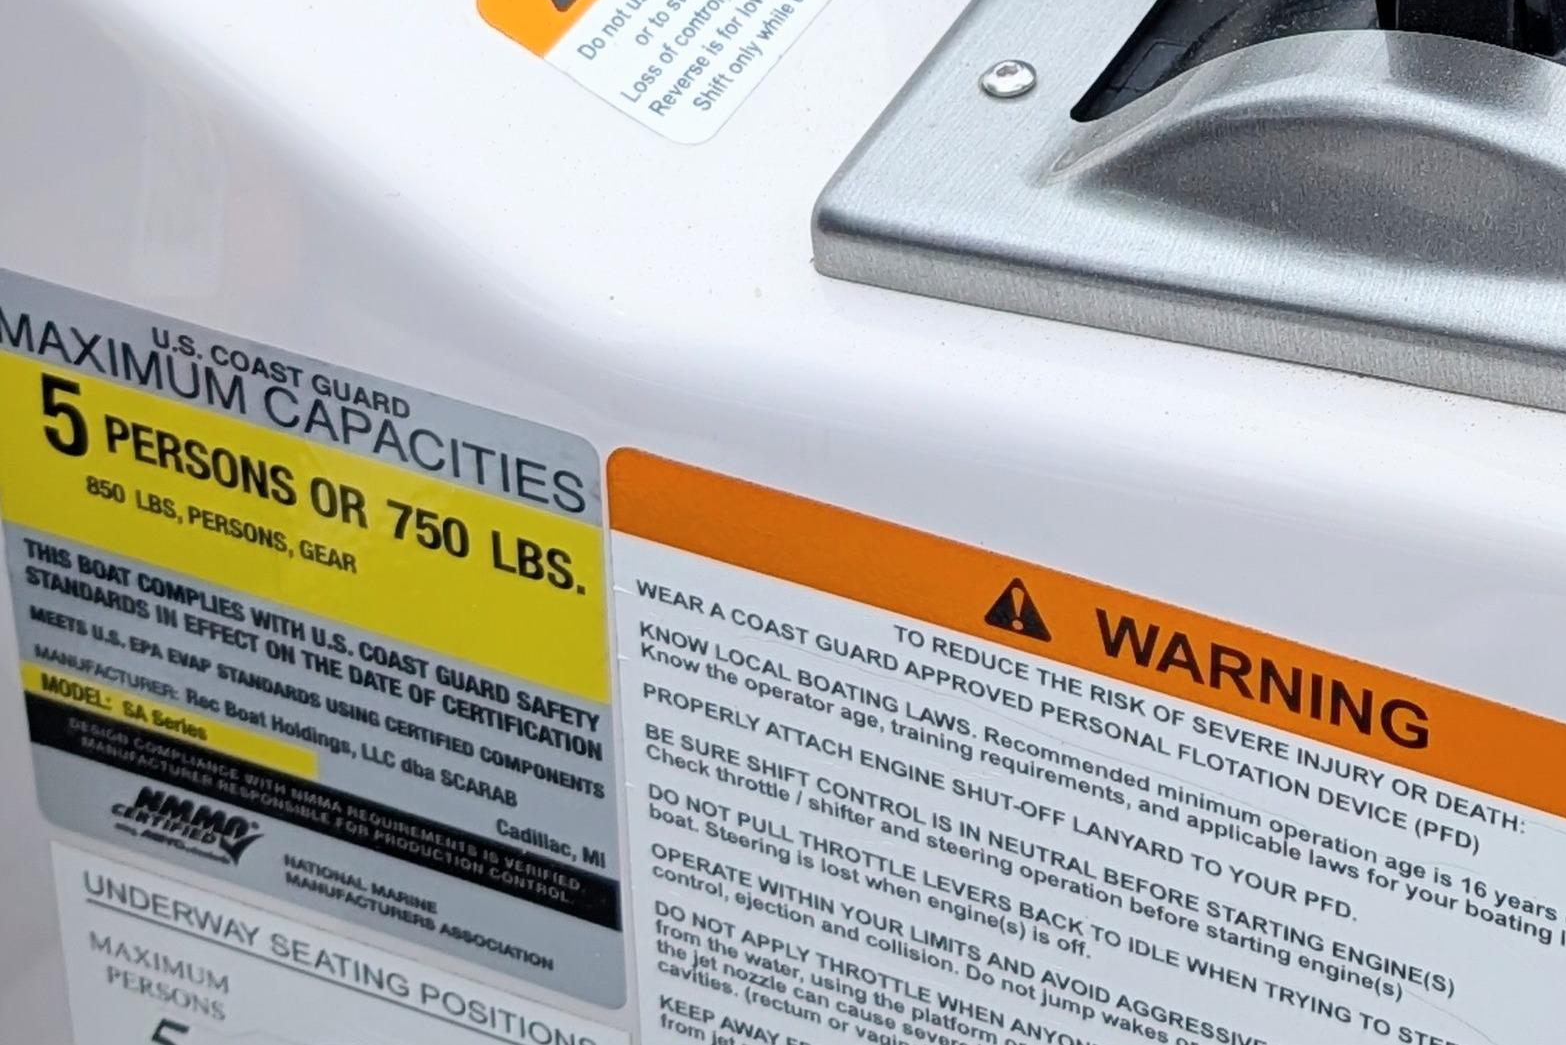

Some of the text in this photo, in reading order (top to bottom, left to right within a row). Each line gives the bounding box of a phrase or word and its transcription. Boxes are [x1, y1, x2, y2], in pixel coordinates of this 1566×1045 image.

[576, 37, 606, 60] Do
[601, 8, 632, 37] not
[620, 65, 663, 103] Loss
[659, 42, 678, 64] of
[635, 26, 654, 46] or
[648, 11, 670, 28] to
[648, 56, 710, 117] Reverse
[701, 40, 724, 56] is
[716, 16, 743, 40] for
[692, 73, 734, 111] Shift
[729, 41, 763, 74] only
[756, 3, 795, 40] while
[0, 305, 586, 513] MAXIMUM CAPACITIES
[152, 327, 410, 419] U.S. COAST GUARD
[41, 373, 585, 595] 5 PERSONS OR 750 LBS.
[86, 475, 357, 574] 850 LBS, PERSONS, GEAR
[23, 538, 600, 733] THIS BOAT COMPLIES WITH U.S. COAST GUARD SAFETY
[25, 565, 603, 761] STANDARDS IN EFFECT ON THE DATE OF CERTIFICATION
[1096, 607, 1429, 750] WARNING
[30, 605, 605, 799] MEETS U.S. EPA EVAP STANDARDS USING CERTIFIED COMPONENTS
[34, 644, 518, 808] MANUFACTURER: Rec Boat Holdings, LLC dba SCARAB
[41, 672, 207, 741] MODEL: SA Series
[636, 579, 1479, 856] WEAR A COAST GUARD APPROVED PERSONAL FLOTATION DEVICE (PFD)
[894, 625, 1524, 833] TO REDUCE THE RISK OF SEVERE INJURY OR DEATH:
[640, 621, 709, 656] KNOW
[715, 644, 791, 682] LOCAL
[798, 669, 899, 713] BOATING
[906, 701, 977, 738] LAWS.
[984, 726, 1150, 792] Recommended
[1157, 783, 1261, 827] minimum
[1269, 819, 1377, 864] operation
[1385, 856, 1426, 879] age
[1434, 867, 1452, 887] is
[1461, 877, 1487, 899] 16
[1494, 890, 1557, 921] years
[641, 642, 700, 673] Know
[705, 663, 738, 685] the
[744, 678, 835, 714] operator
[840, 707, 884, 733] age,
[890, 719, 973, 762] training
[980, 749, 1131, 810] requirements,
[1138, 799, 1179, 822] and
[1186, 815, 1302, 861] applicable
[1309, 848, 1359, 879] laws
[1367, 868, 1399, 891] for
[1405, 883, 1459, 910] your
[1465, 898, 1553, 945] boating
[643, 682, 1356, 921] PROPERLY ATTACH ENGINE SHUT-OFF LANYARD TO YOUR PFD.
[284, 854, 437, 914] NATIONAL MARINE
[496, 818, 606, 869] Cadillac, MI
[84, 871, 260, 946] UNDERWAY
[270, 933, 410, 998] SEATING
[89, 931, 229, 994] MAXIMUM
[285, 871, 554, 971] MANUFACTURERS ASSOCIATION
[106, 965, 226, 1021] PERSONS
